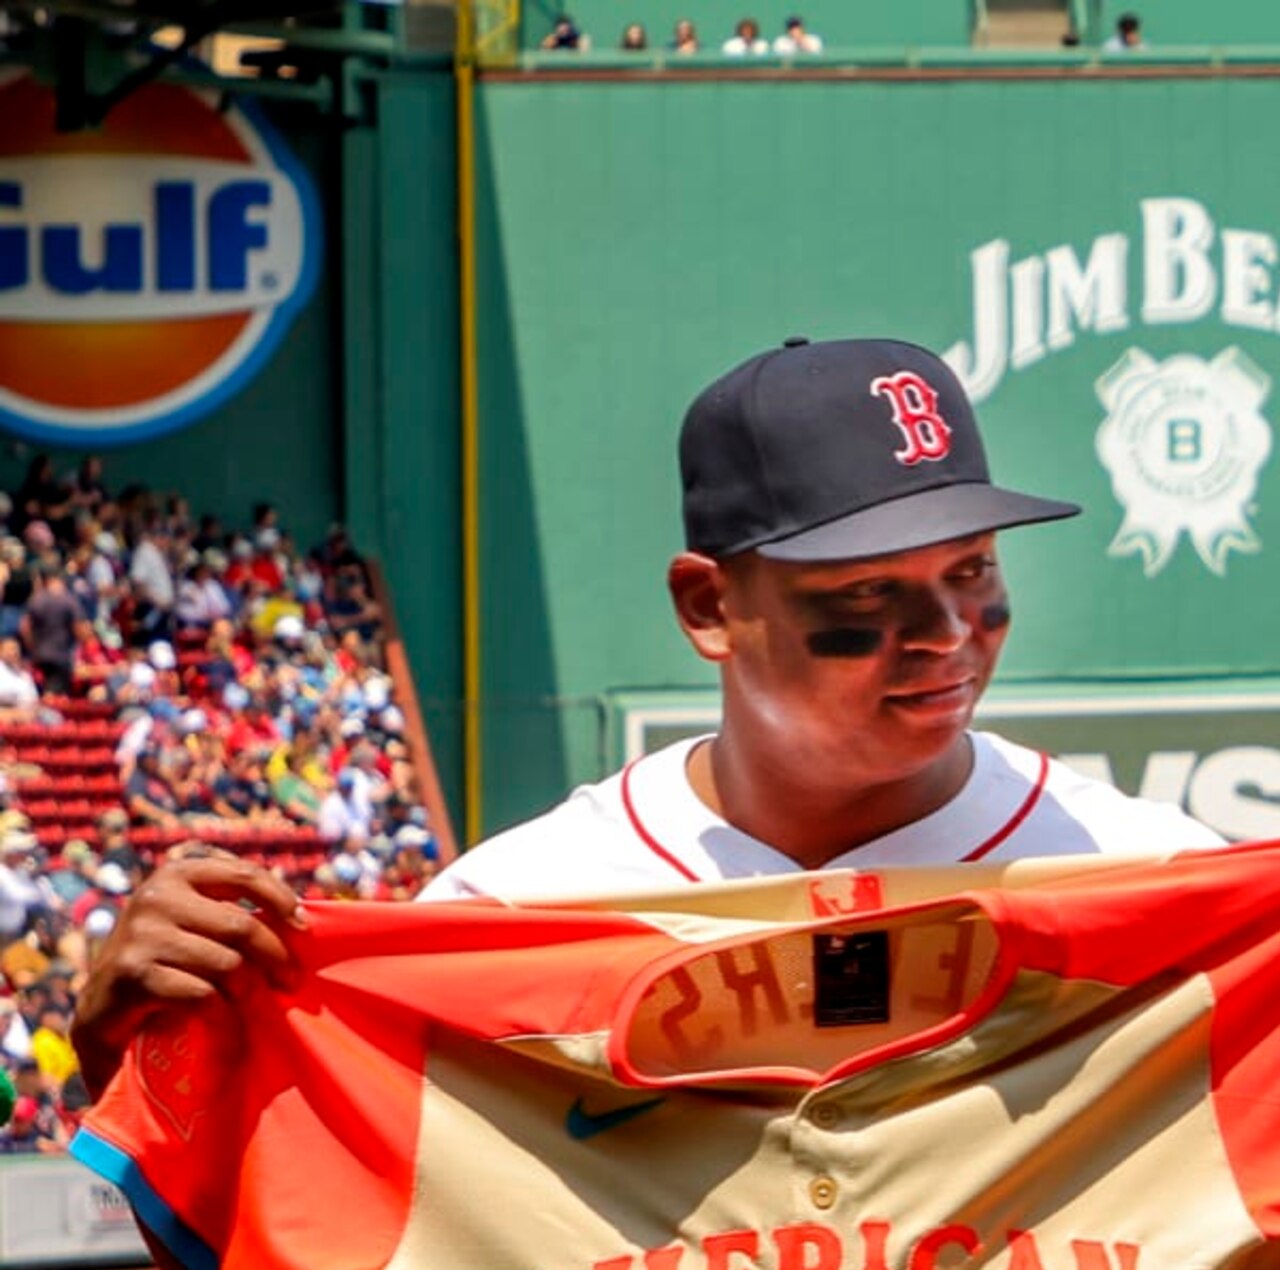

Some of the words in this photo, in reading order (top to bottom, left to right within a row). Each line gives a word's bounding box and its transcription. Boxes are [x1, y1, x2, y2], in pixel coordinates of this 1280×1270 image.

[0, 180, 272, 293] ulf
[944, 233, 1128, 402] JIM
[870, 370, 953, 466] B
[1167, 418, 1202, 462] B
